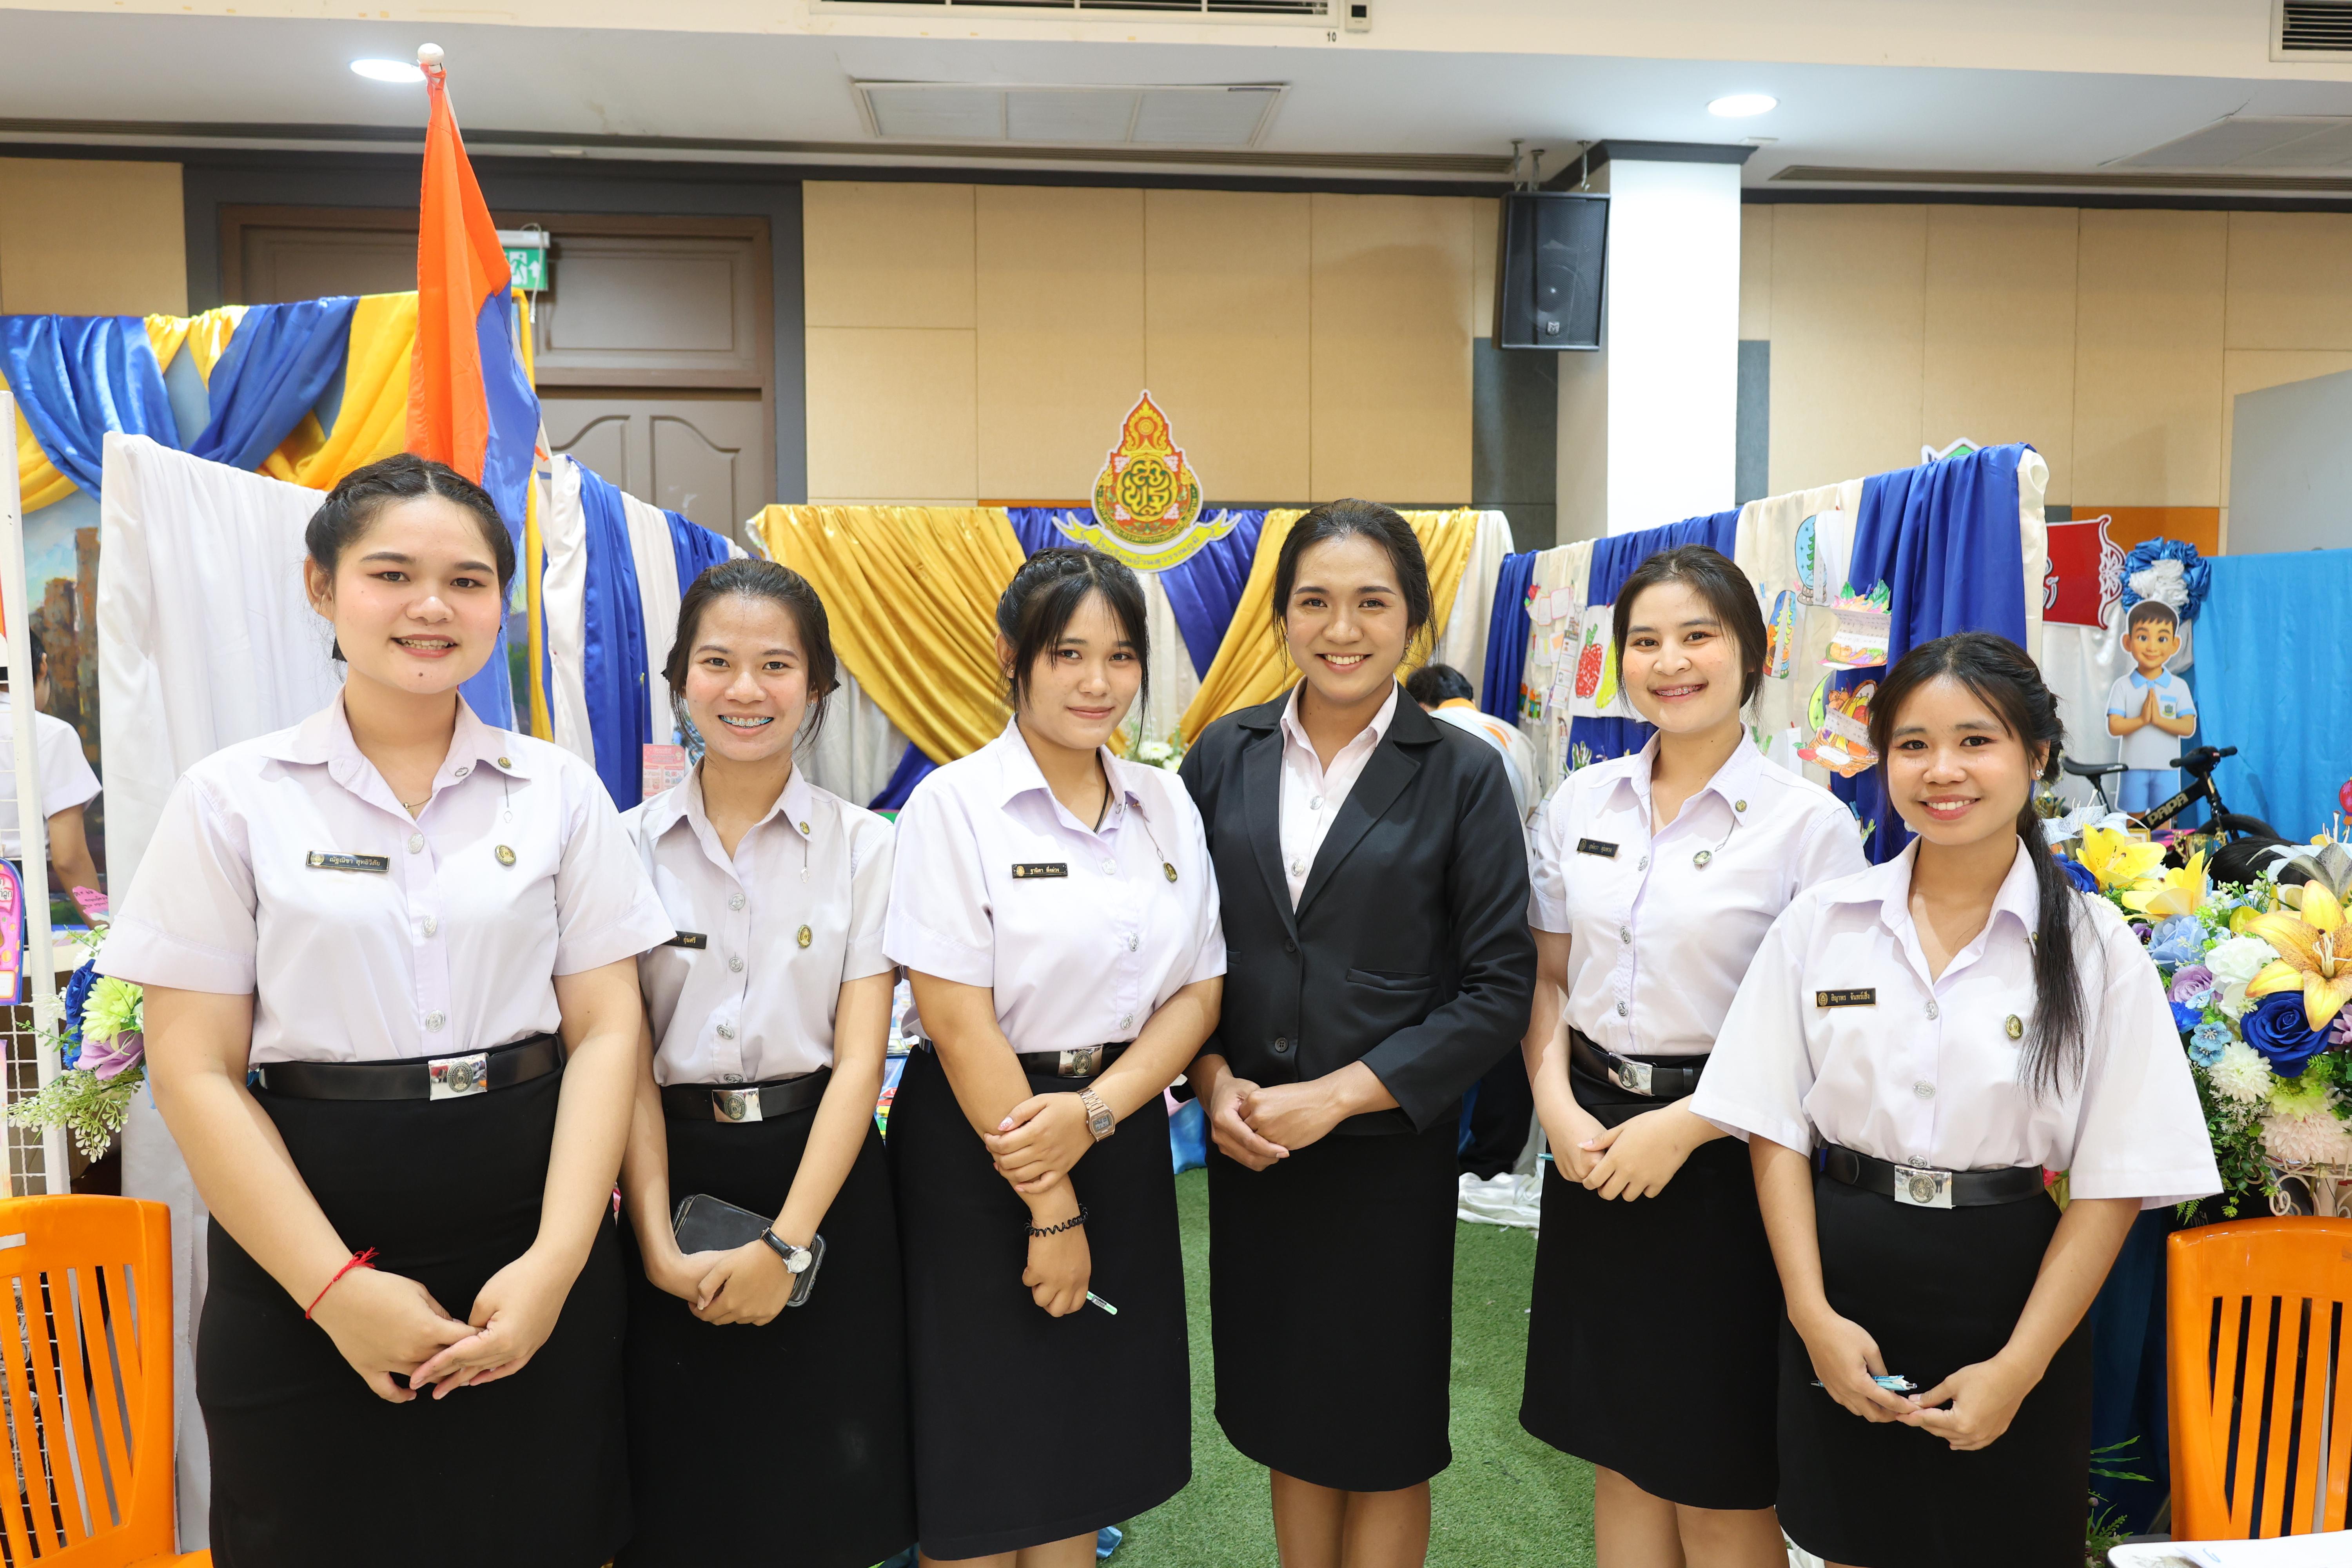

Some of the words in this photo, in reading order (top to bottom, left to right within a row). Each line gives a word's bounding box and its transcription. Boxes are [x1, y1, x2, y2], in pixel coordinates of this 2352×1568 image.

[1327, 31, 1337, 42] 10
[2147, 792, 2189, 826] PAPA
[329, 856, 353, 864] ณัฐณิชา
